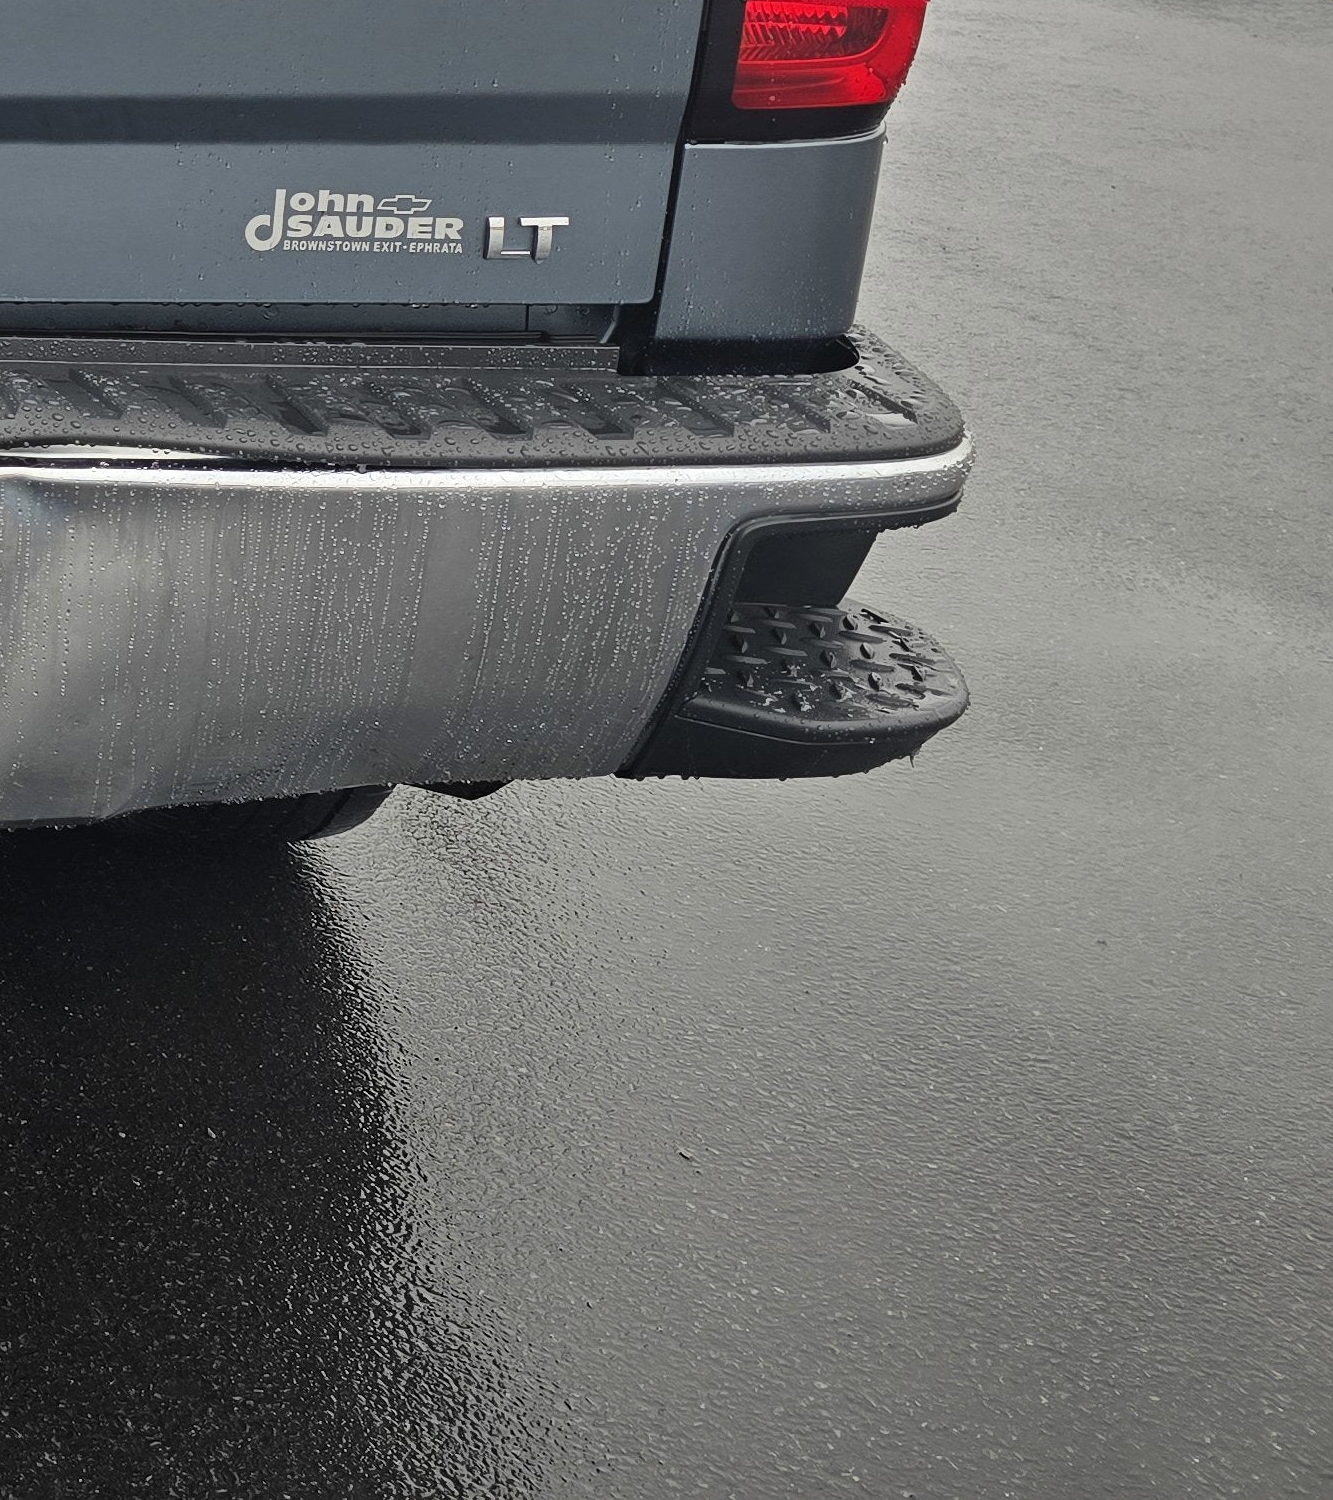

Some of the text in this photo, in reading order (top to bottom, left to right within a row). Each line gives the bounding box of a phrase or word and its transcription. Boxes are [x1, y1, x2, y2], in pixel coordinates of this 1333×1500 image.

[245, 188, 374, 251] John
[286, 214, 464, 239] SAUDER
[283, 239, 370, 252] BROWNSTOWN
[483, 216, 570, 260] LT
